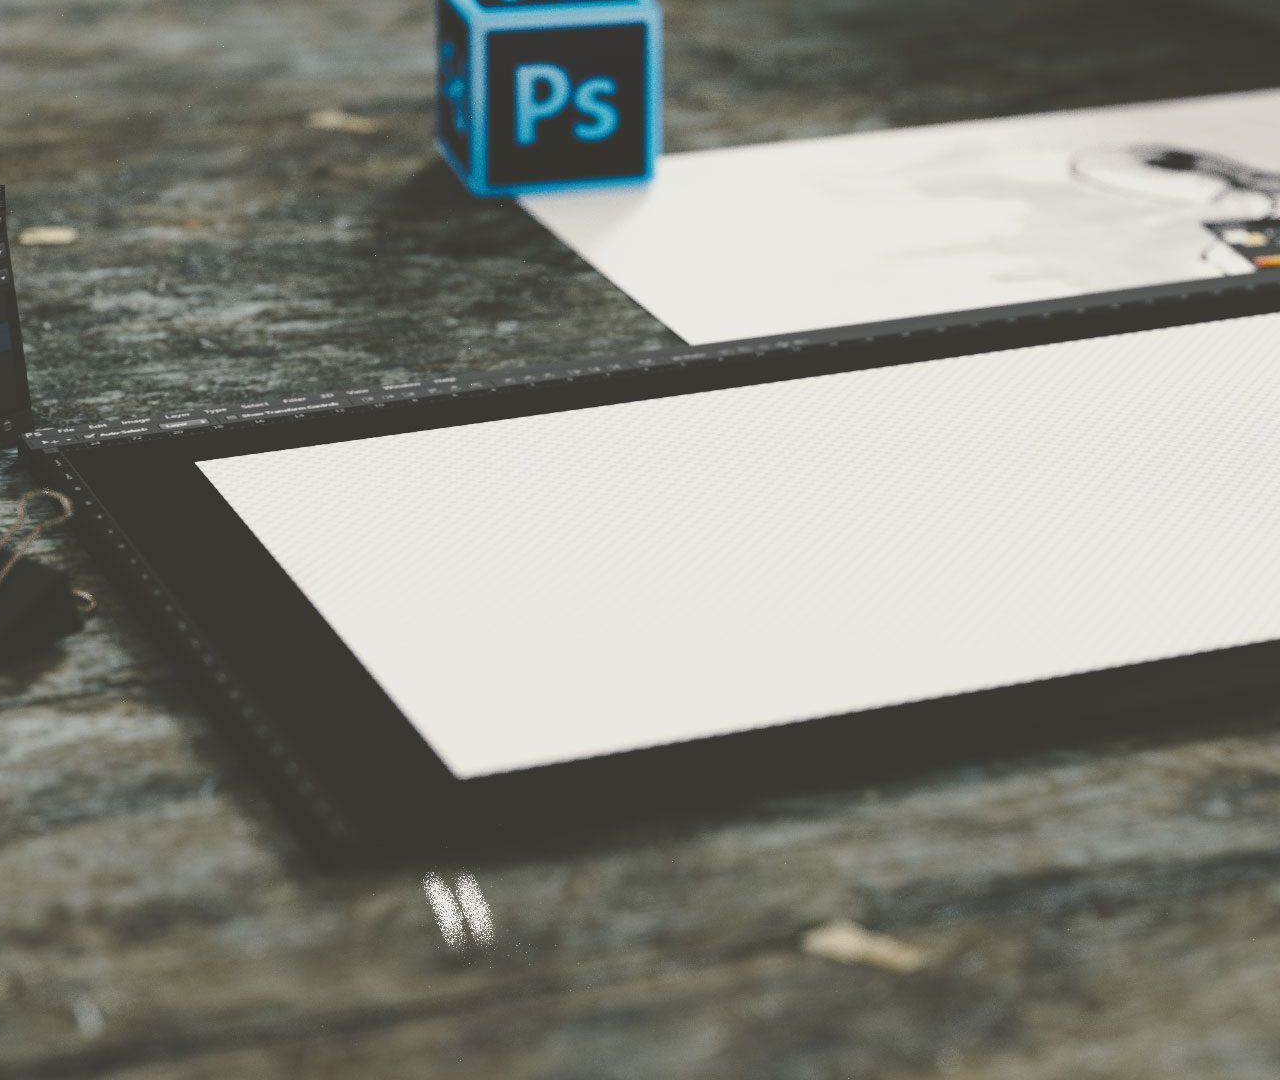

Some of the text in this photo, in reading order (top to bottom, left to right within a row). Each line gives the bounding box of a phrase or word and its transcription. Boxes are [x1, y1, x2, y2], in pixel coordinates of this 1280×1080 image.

[513, 62, 620, 146] Ps
[88, 422, 108, 430] Edit
[120, 416, 151, 425] Image
[164, 411, 191, 420] Layer
